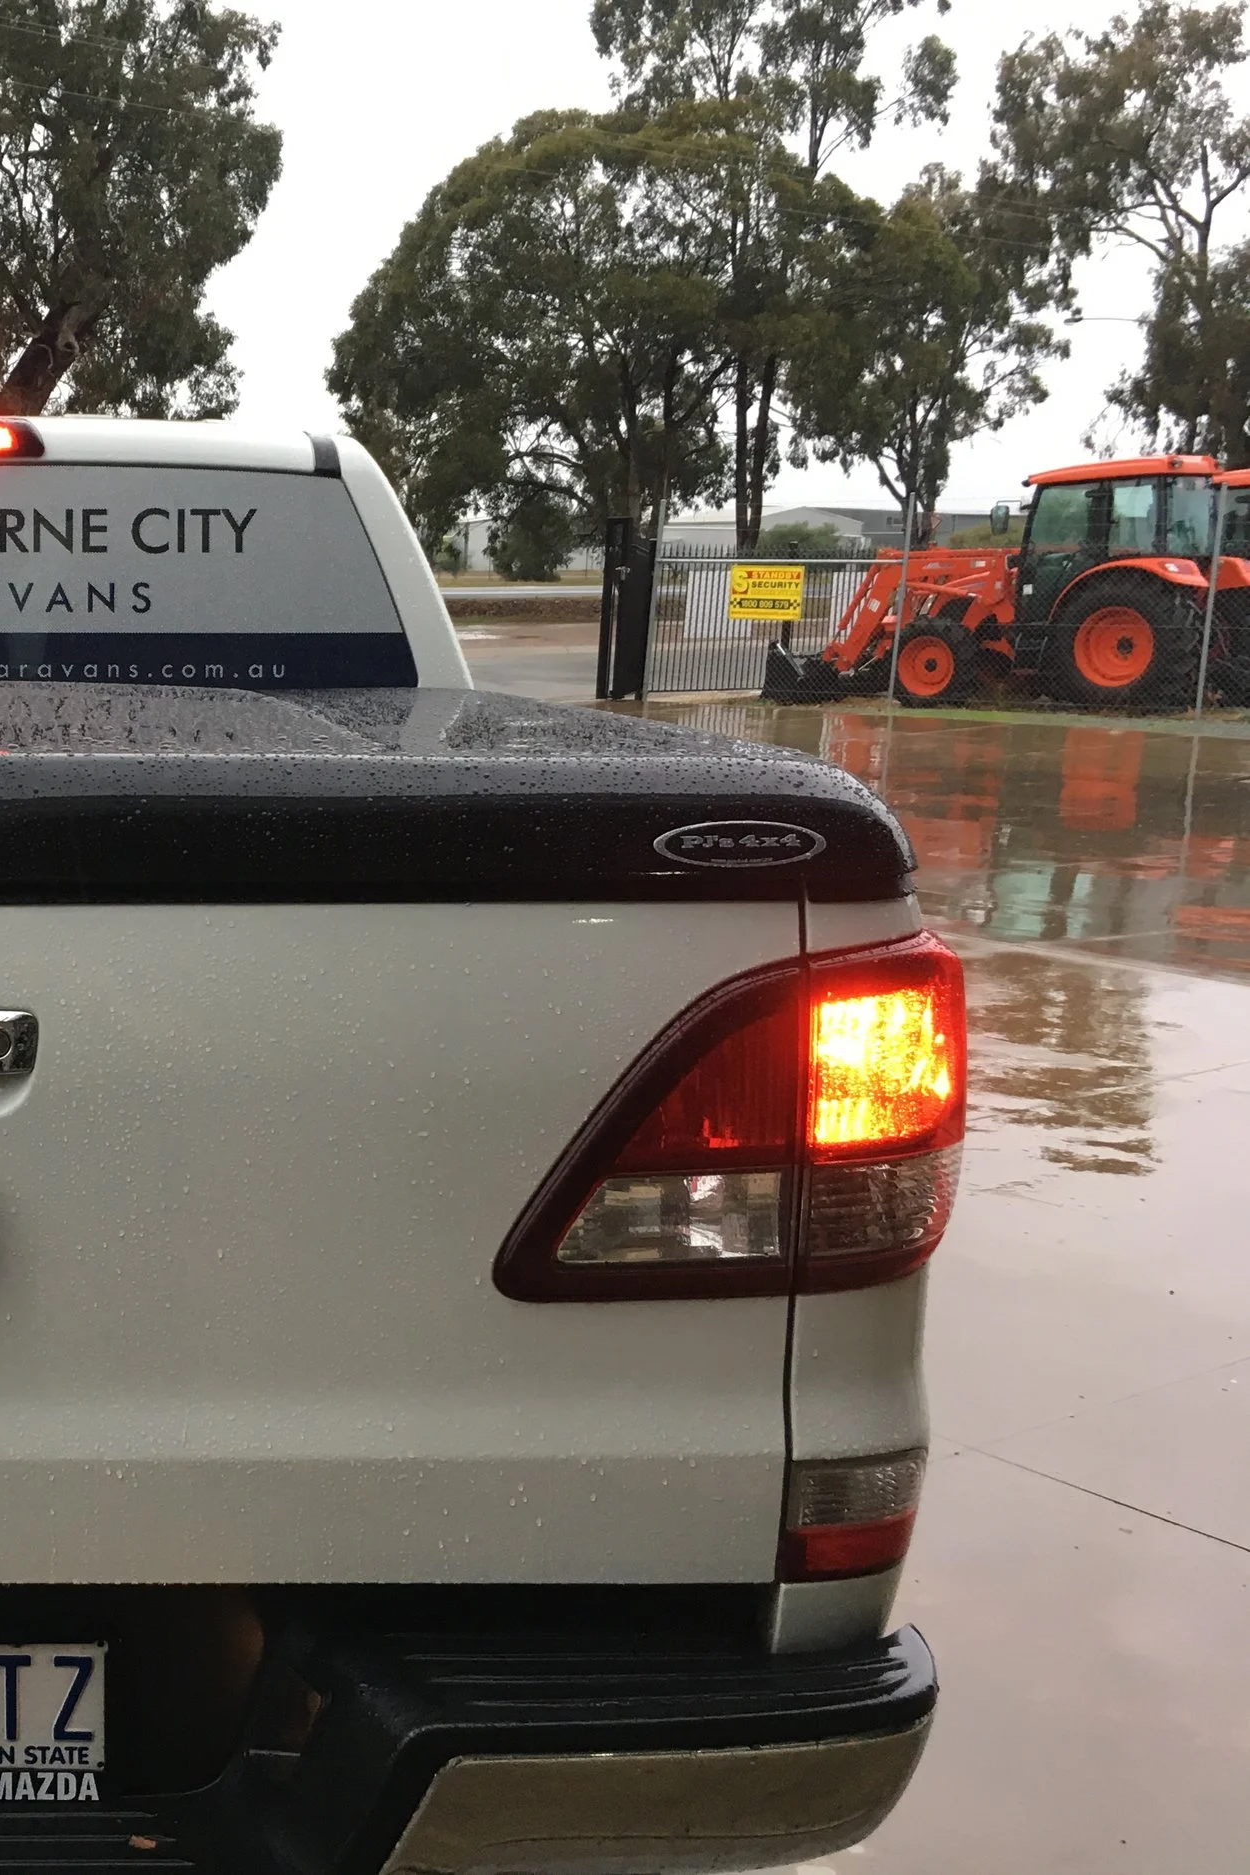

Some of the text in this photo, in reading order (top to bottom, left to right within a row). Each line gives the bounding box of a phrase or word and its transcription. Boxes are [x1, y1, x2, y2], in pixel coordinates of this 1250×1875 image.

[130, 507, 258, 554] CITY
[751, 571, 799, 579] STANDBY
[738, 833, 801, 848] 4x4
[24, 1745, 90, 1766] STATE
